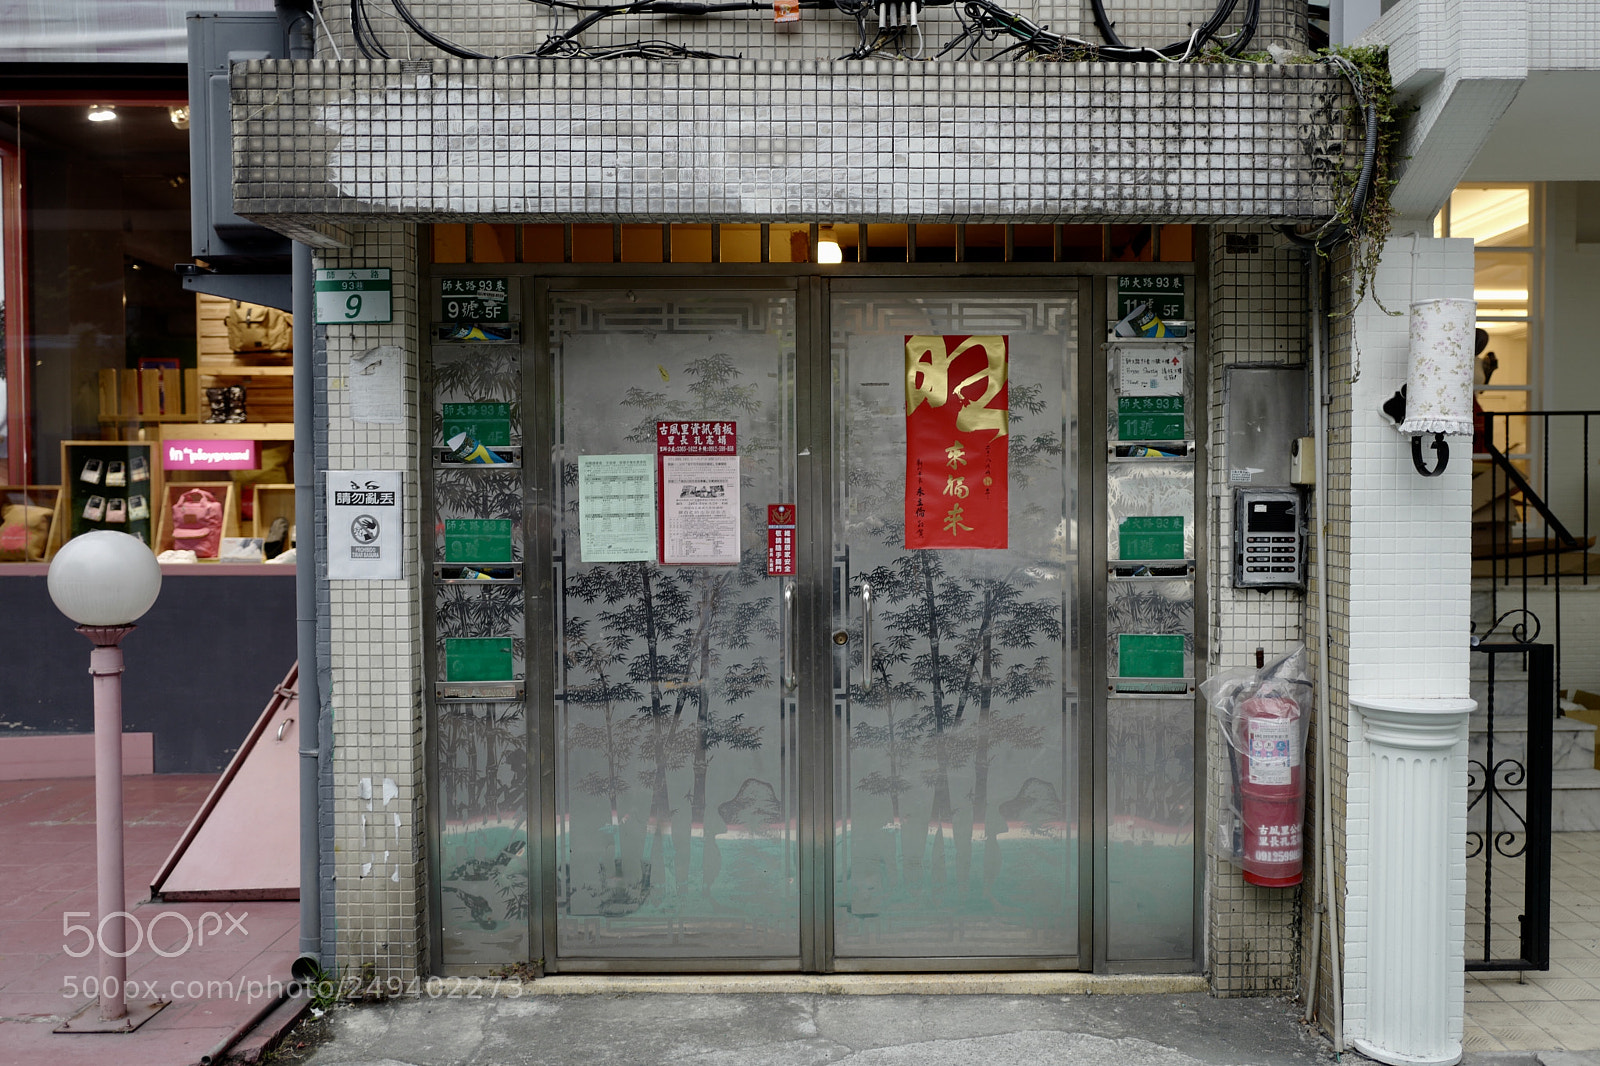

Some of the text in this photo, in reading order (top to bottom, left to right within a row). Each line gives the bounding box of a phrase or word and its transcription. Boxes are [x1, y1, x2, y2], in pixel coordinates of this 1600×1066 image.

[326, 270, 380, 279] 師大路
[341, 281, 363, 290] 93巷
[345, 294, 362, 319] 9
[485, 306, 502, 319] 5F
[1163, 304, 1179, 316] 5F
[659, 423, 734, 435] 古風里資訊看板
[1124, 418, 1180, 437] 11號 4F
[487, 431, 504, 443] 4F
[169, 447, 184, 461] in
[189, 448, 250, 465] playground
[336, 492, 394, 505] 請勿亂丟
